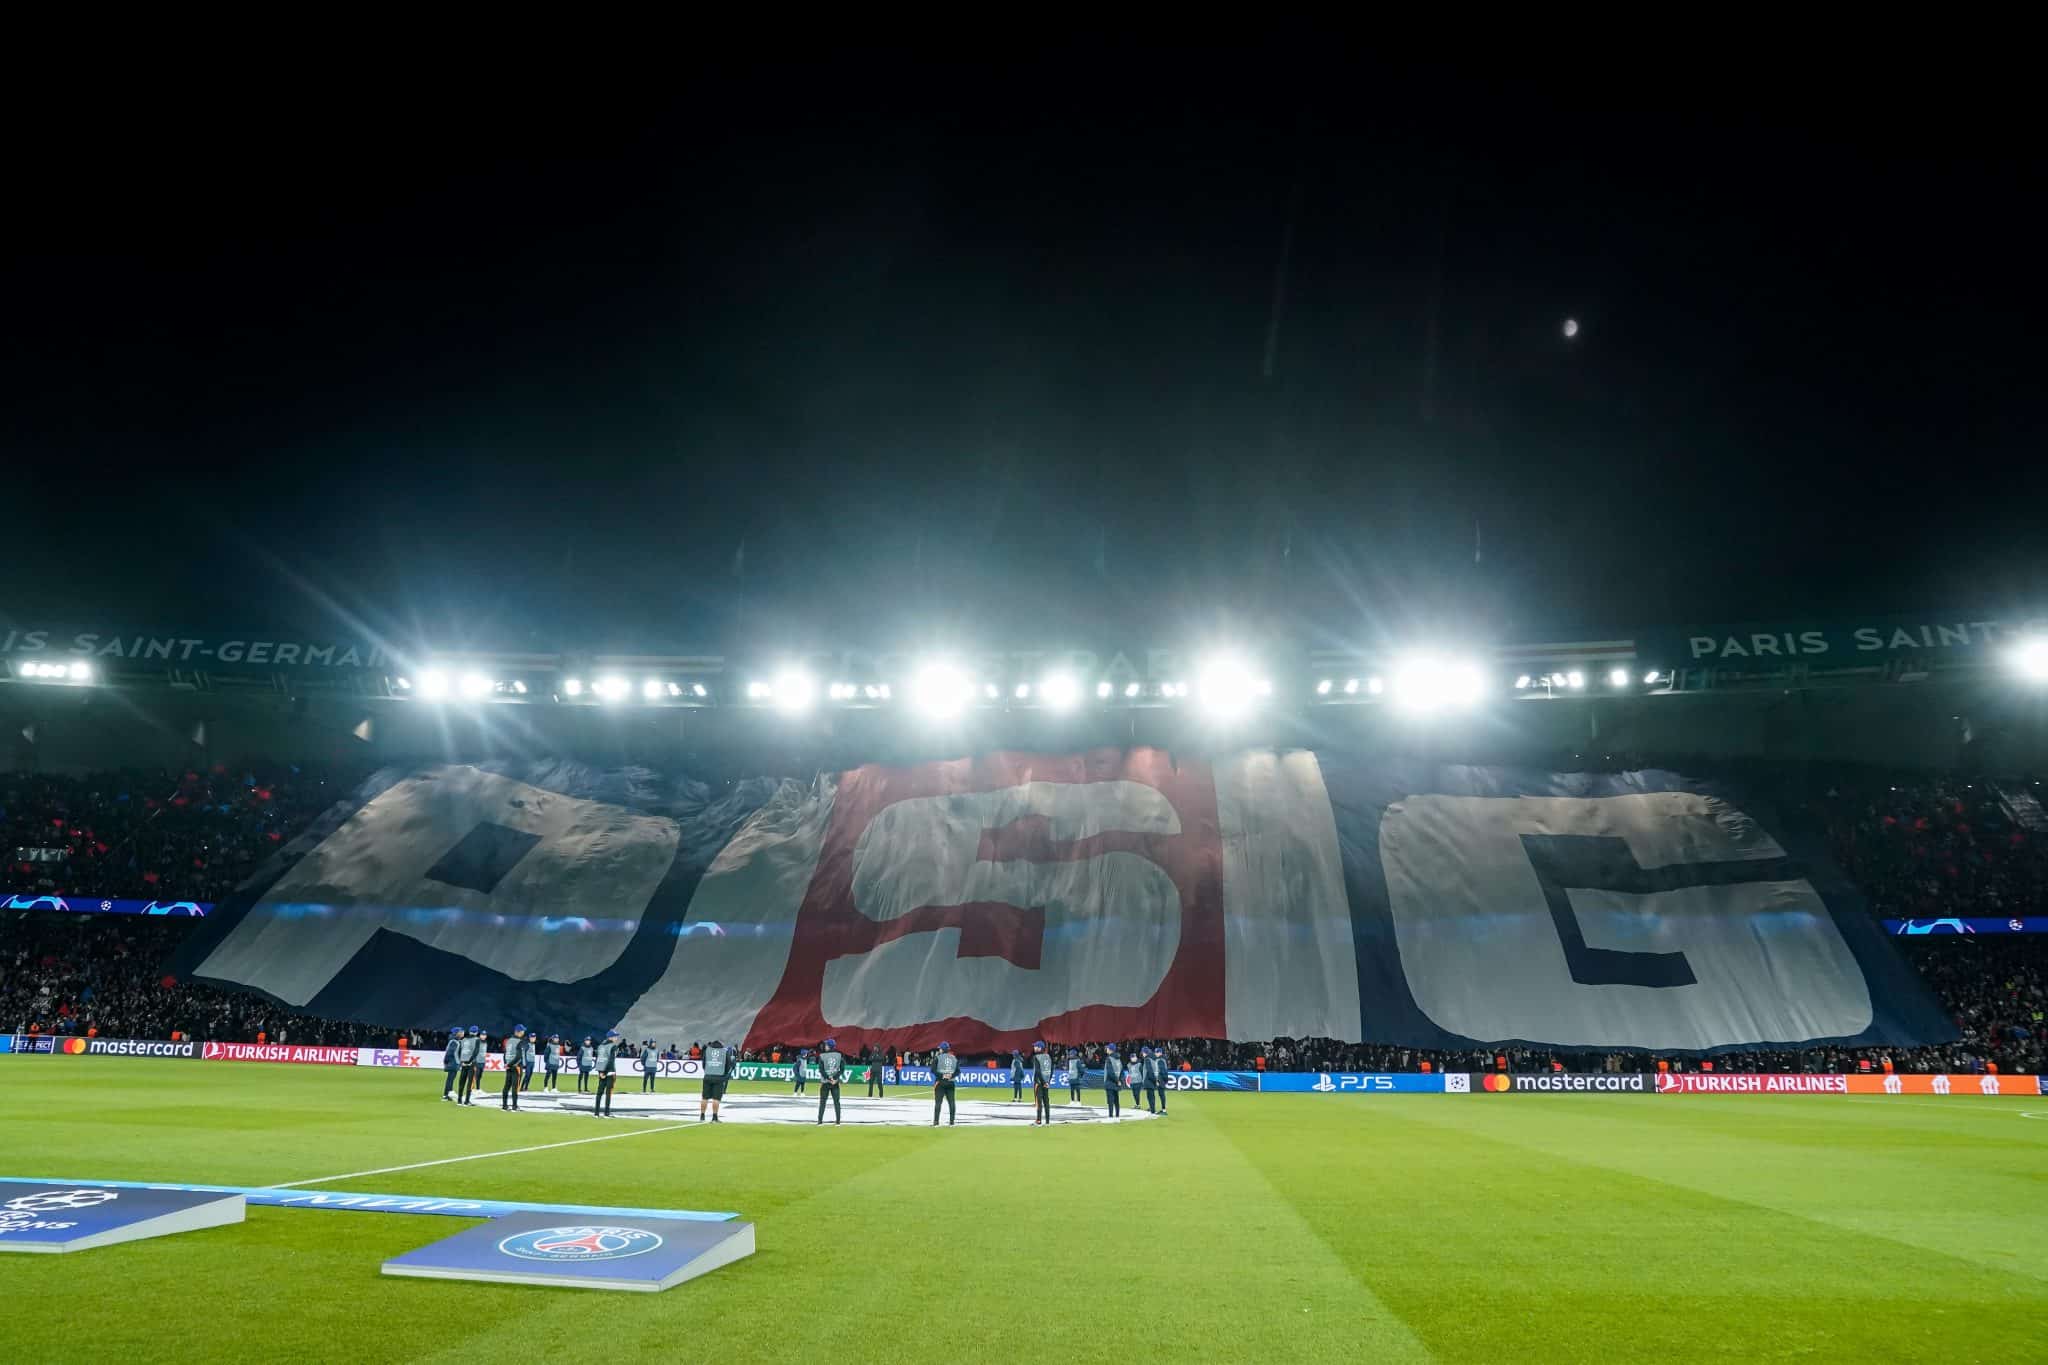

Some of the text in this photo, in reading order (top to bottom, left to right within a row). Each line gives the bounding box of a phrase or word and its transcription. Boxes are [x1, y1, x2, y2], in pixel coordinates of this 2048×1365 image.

[1690, 631, 1828, 658] PARIS
[90, 1039, 193, 1057] mastercard
[227, 1045, 357, 1063] TURKISH AIRLINES
[373, 1049, 420, 1067] FedEx
[901, 1071, 932, 1083] UEFA
[1165, 1072, 1208, 1090] epsi
[1517, 1074, 1643, 1091] mastercard
[1686, 1076, 1845, 1091] TURKISH AIRLINES
